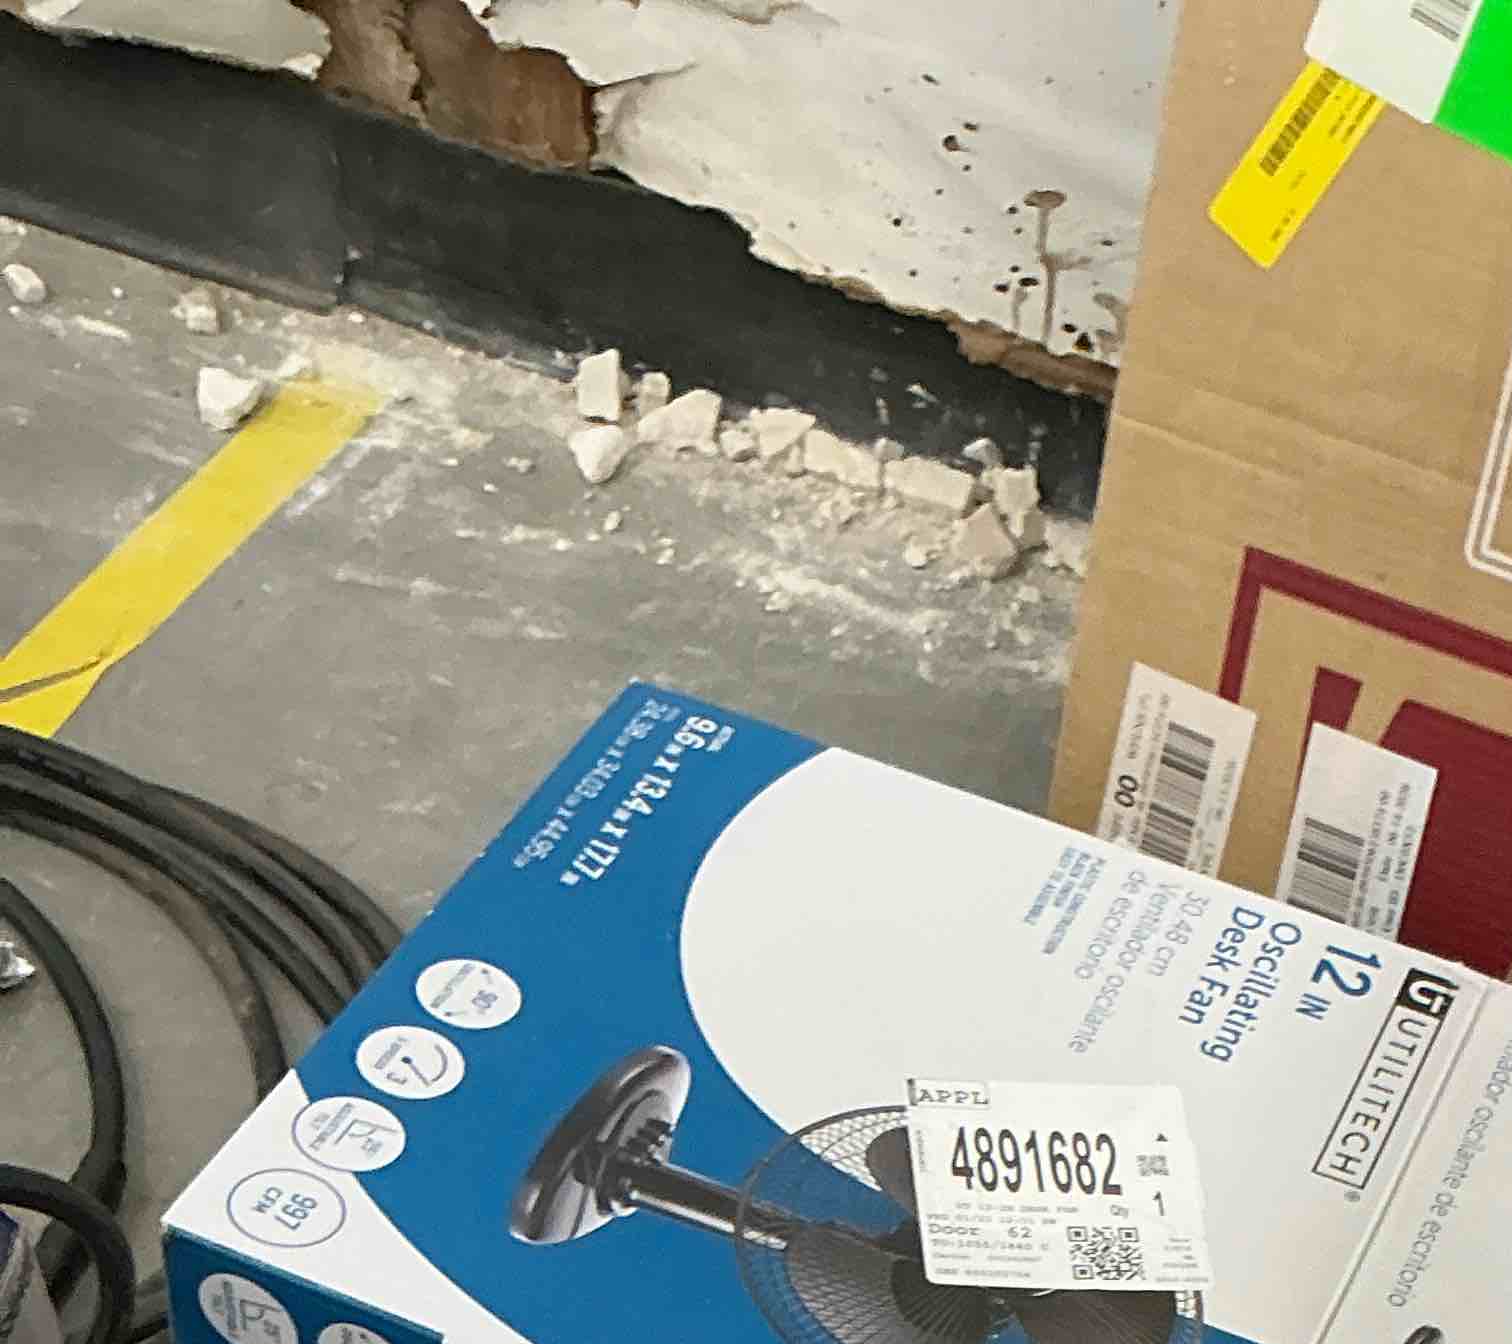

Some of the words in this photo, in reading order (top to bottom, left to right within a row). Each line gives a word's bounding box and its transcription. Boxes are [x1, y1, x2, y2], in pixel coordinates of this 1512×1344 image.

[1121, 870, 1149, 895] de
[1206, 906, 1265, 973] Desk
[1146, 946, 1176, 977] cm
[1310, 943, 1384, 998] 12
[1178, 974, 1230, 1025] Fan
[1199, 921, 1303, 1064] Oscillating
[1295, 992, 1332, 1021] IN
[919, 1088, 989, 1105] APPL
[1328, 1017, 1429, 1177] UTILITECH
[951, 1126, 1122, 1196] 4891682
[1441, 1106, 1494, 1190] oscilante
[251, 1186, 283, 1215] CFM
[273, 1193, 318, 1231] 997
[1152, 1191, 1165, 1217] 1
[1430, 1192, 1457, 1217] de
[928, 1223, 981, 1236] Door
[1007, 1226, 1033, 1239] 62
[1388, 1220, 1442, 1308] escritorio
